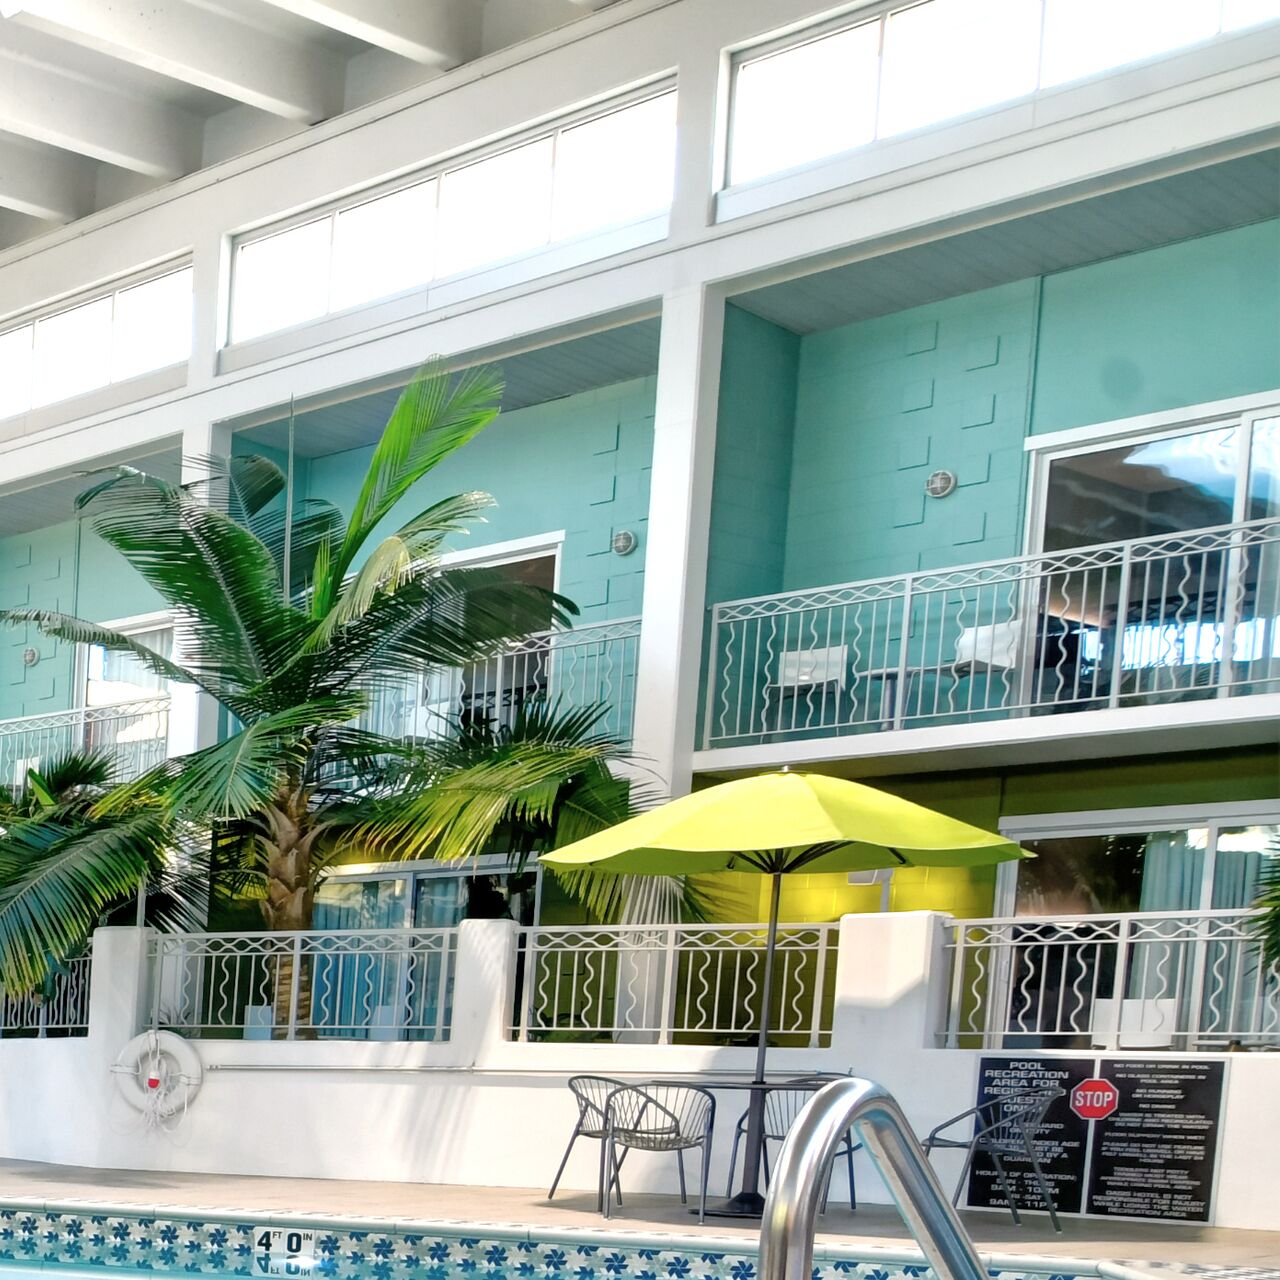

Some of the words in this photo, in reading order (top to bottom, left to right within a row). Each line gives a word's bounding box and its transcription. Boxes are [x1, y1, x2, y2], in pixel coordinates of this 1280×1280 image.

[1010, 1062, 1045, 1070] POOL
[984, 1070, 1069, 1079] RECREATION
[992, 1079, 1028, 1087] AREA
[1076, 1091, 1113, 1108] STOP
[1027, 1186, 1060, 1194] 10M
[257, 1231, 272, 1251] 4
[287, 1232, 302, 1253] 0
[303, 1233, 313, 1241] IN
